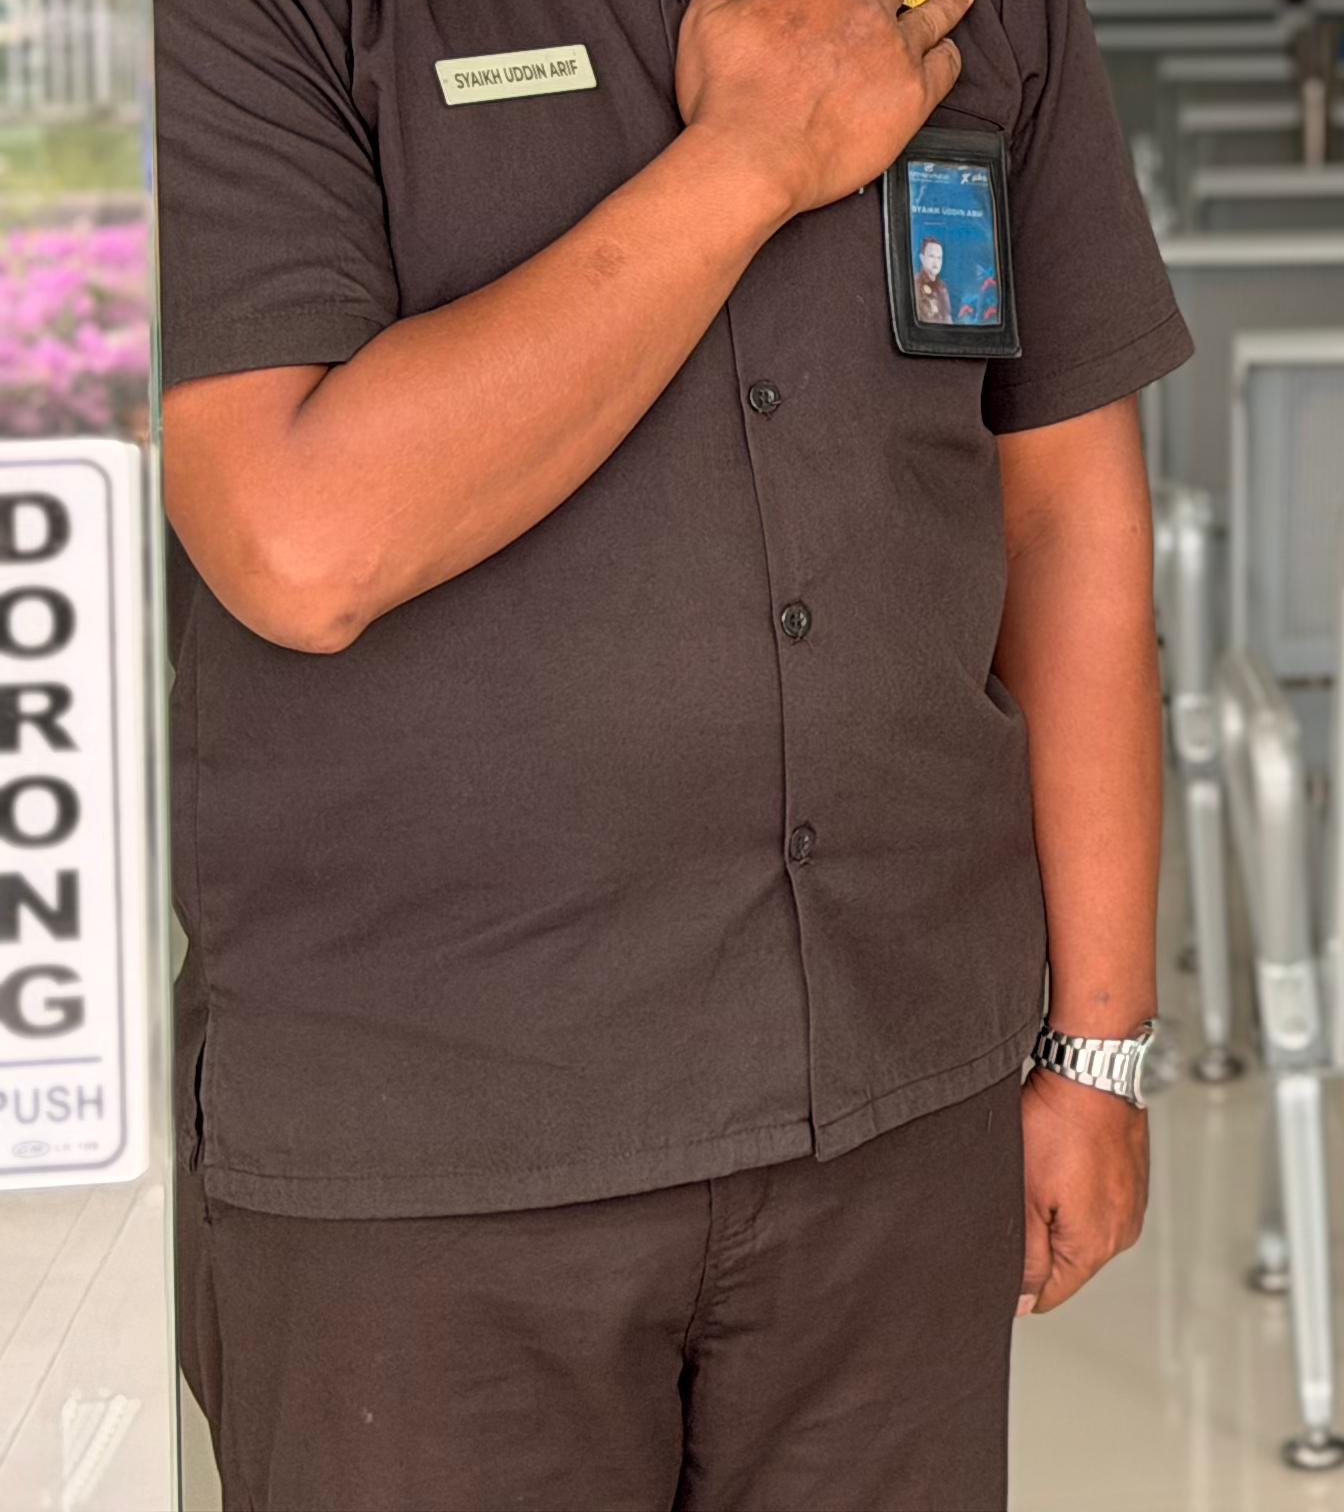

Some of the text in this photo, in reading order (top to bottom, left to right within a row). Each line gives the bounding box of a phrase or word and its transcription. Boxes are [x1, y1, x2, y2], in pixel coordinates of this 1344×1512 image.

[454, 59, 578, 89] SYAIKH UDDIN ARIF
[0, 493, 86, 1040] DORONG
